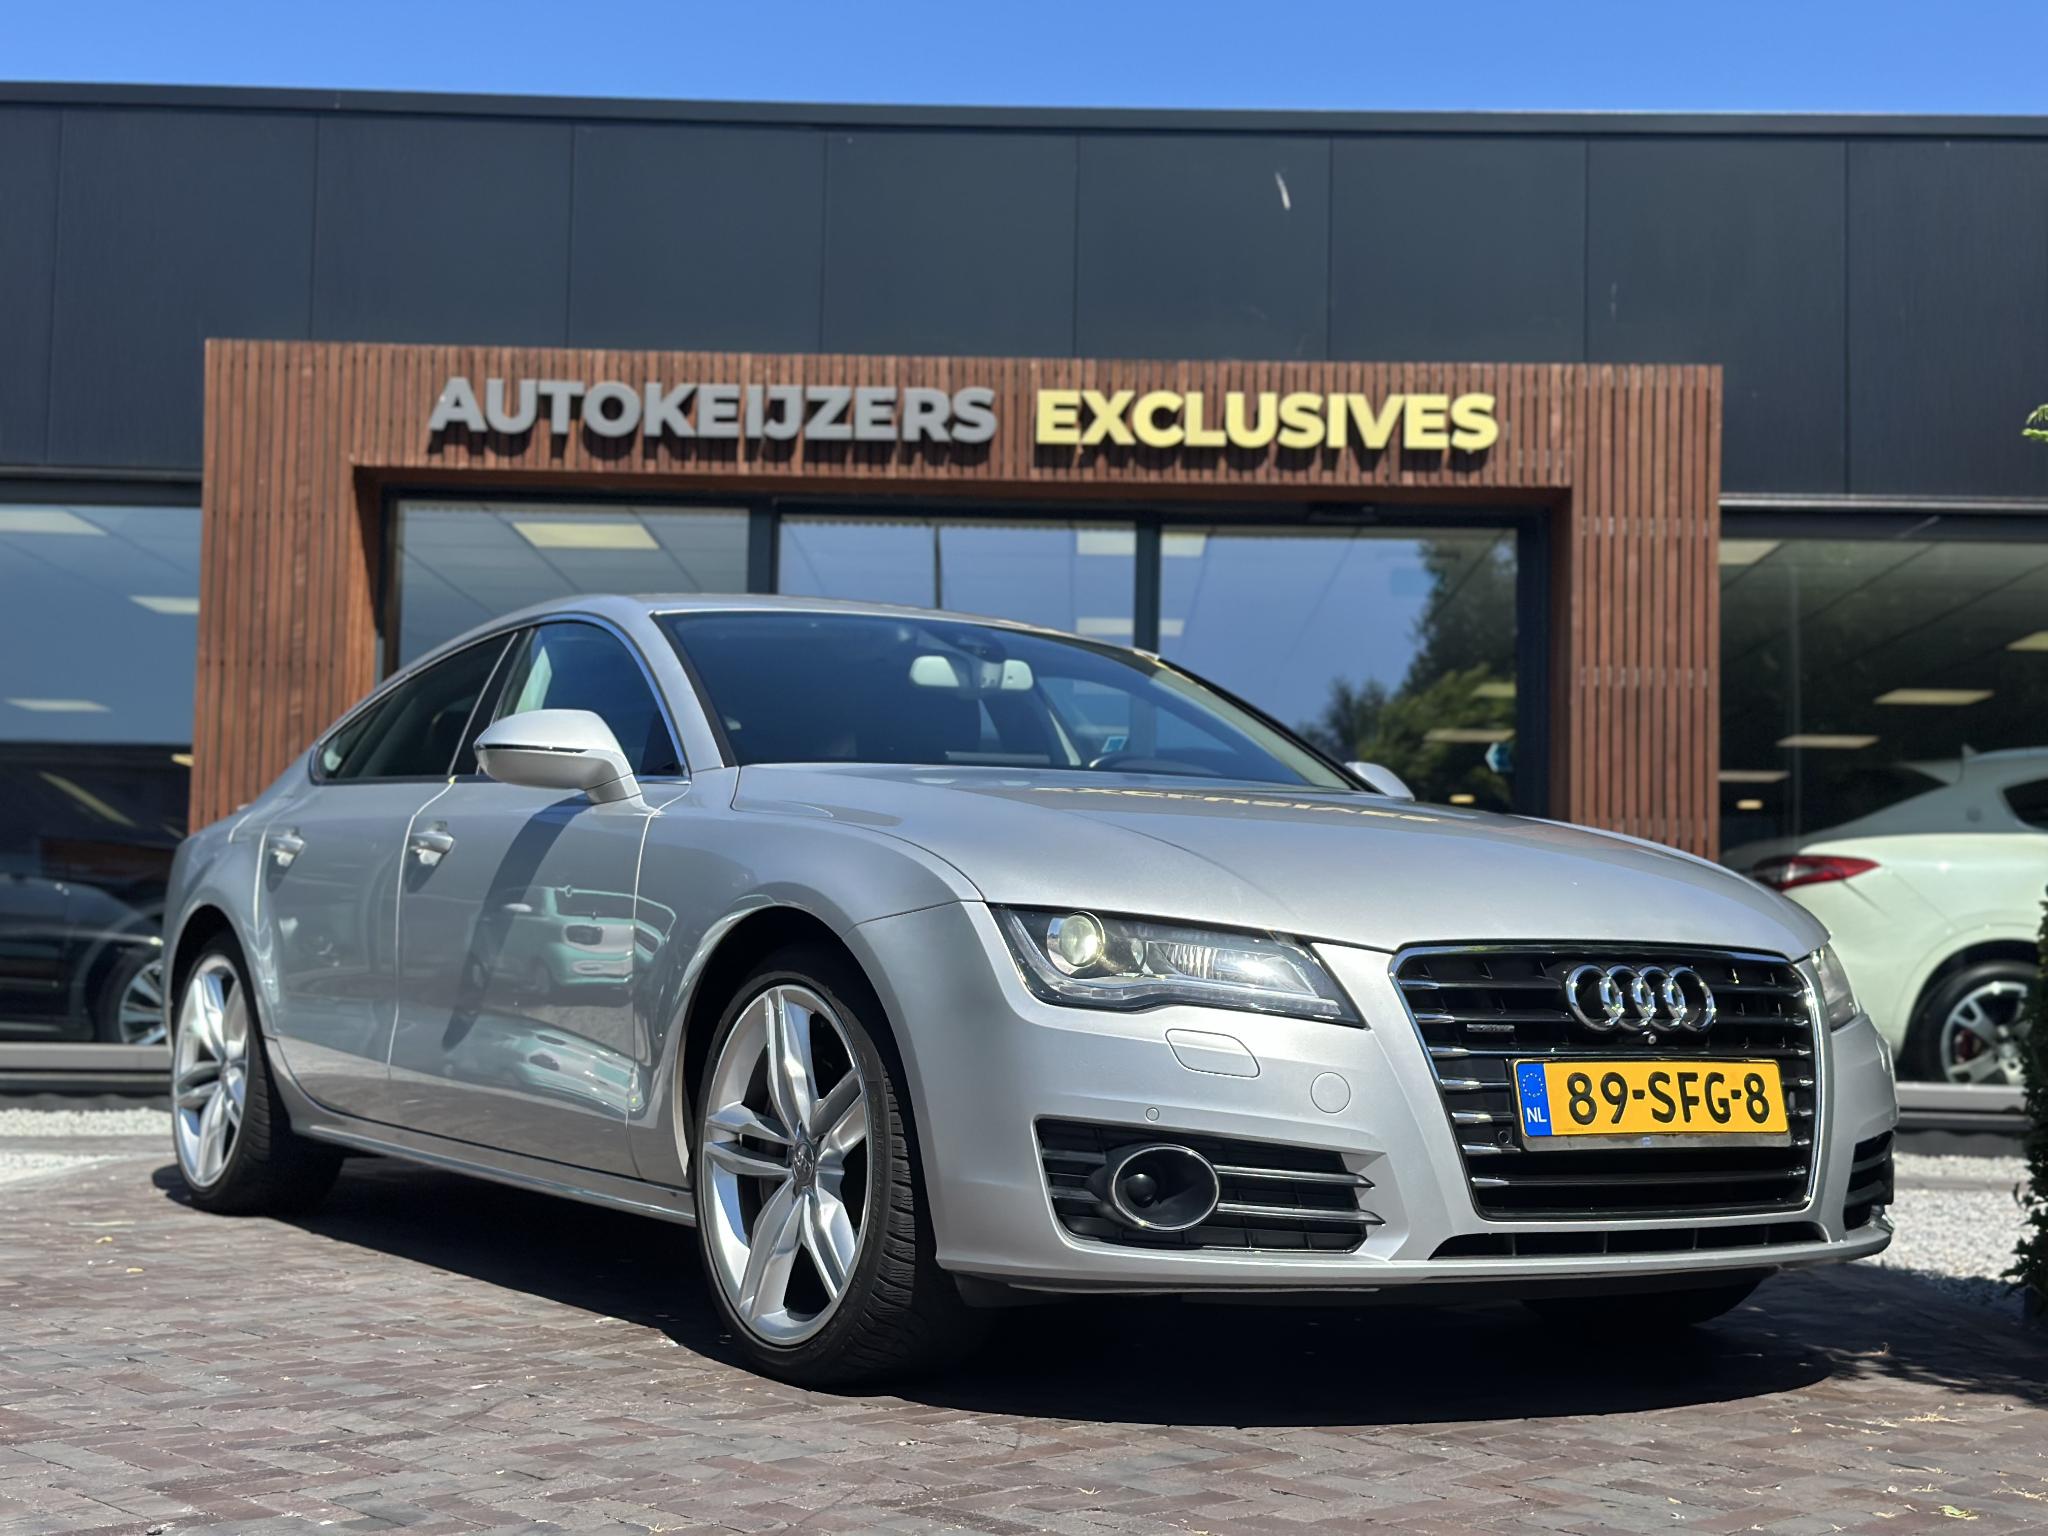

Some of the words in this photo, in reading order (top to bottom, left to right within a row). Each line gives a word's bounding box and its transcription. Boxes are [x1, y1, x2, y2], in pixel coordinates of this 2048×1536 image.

[430, 377, 998, 443] AUTOKEIJZERS
[1036, 390, 1499, 451] EXCLUSIVES
[1526, 1106, 1548, 1124] NL
[1566, 1071, 1770, 1126] 89-SFG-8
